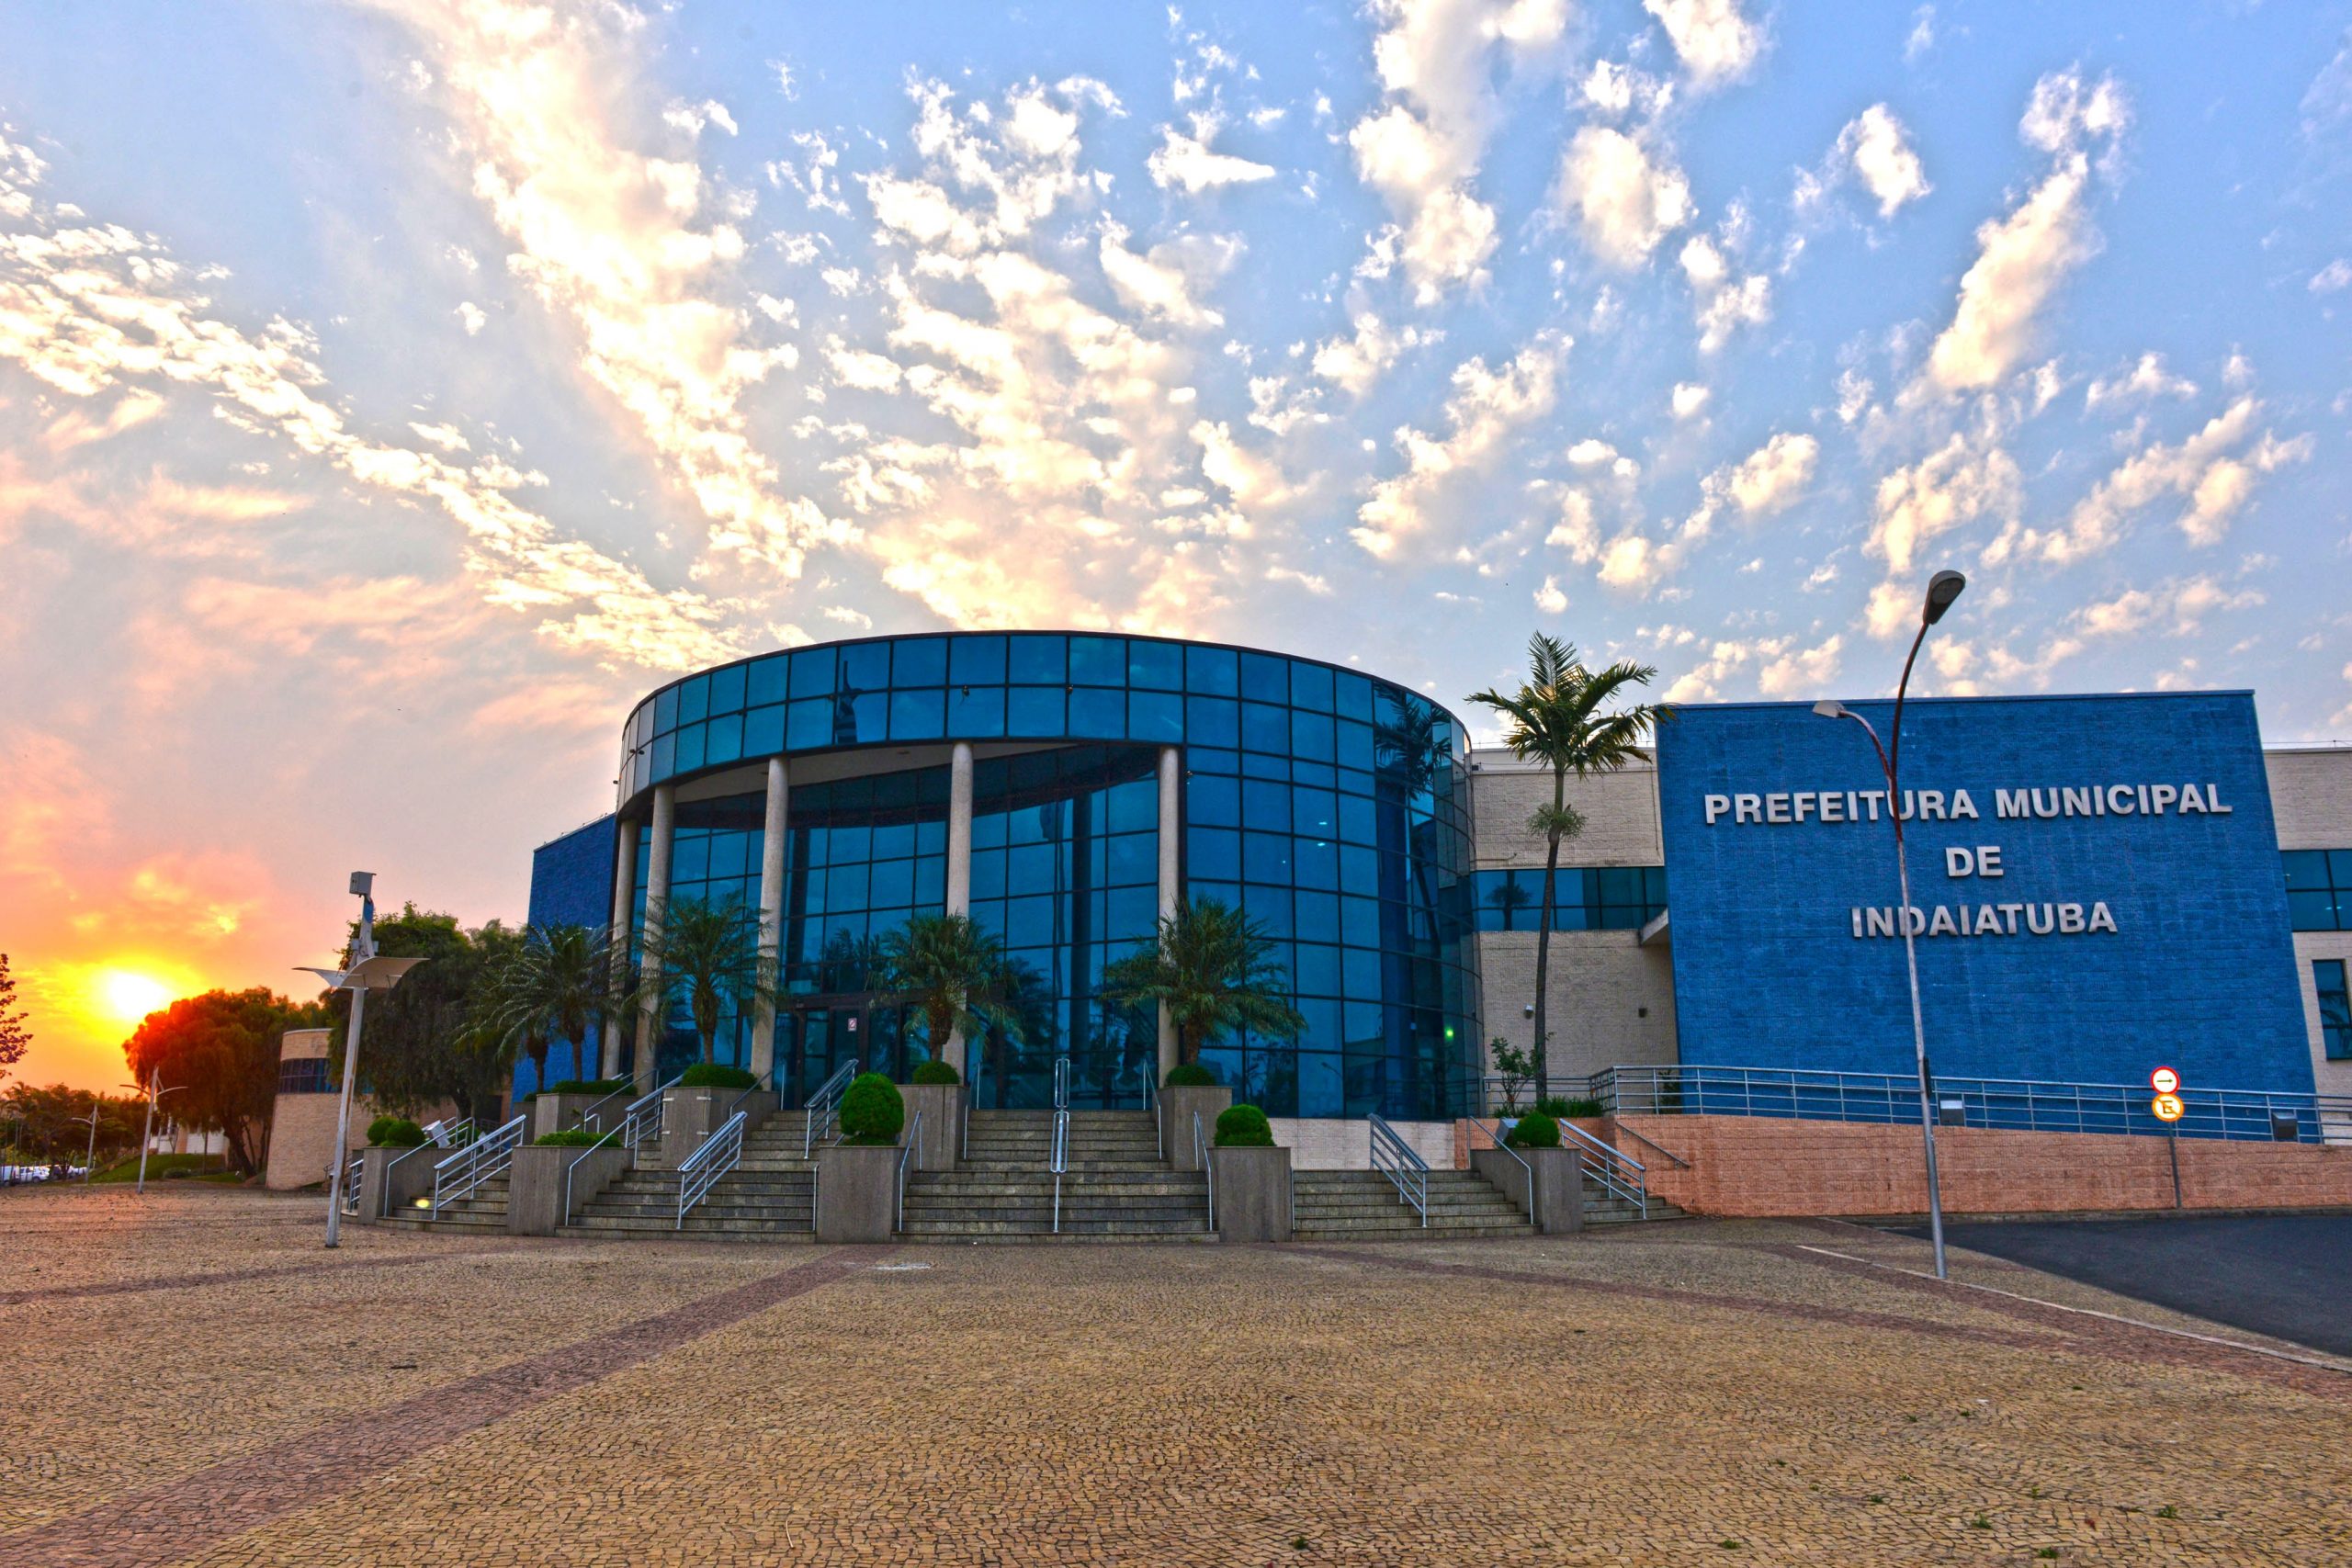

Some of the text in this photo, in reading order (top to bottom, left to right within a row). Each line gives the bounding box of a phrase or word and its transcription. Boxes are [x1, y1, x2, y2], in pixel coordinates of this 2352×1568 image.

[1704, 784, 2233, 824] PREFEITURA MUNICIPAL
[1945, 846, 2004, 877] DE
[1851, 901, 2118, 937] INDAIATUBA
[2161, 1100, 2174, 1114] E
